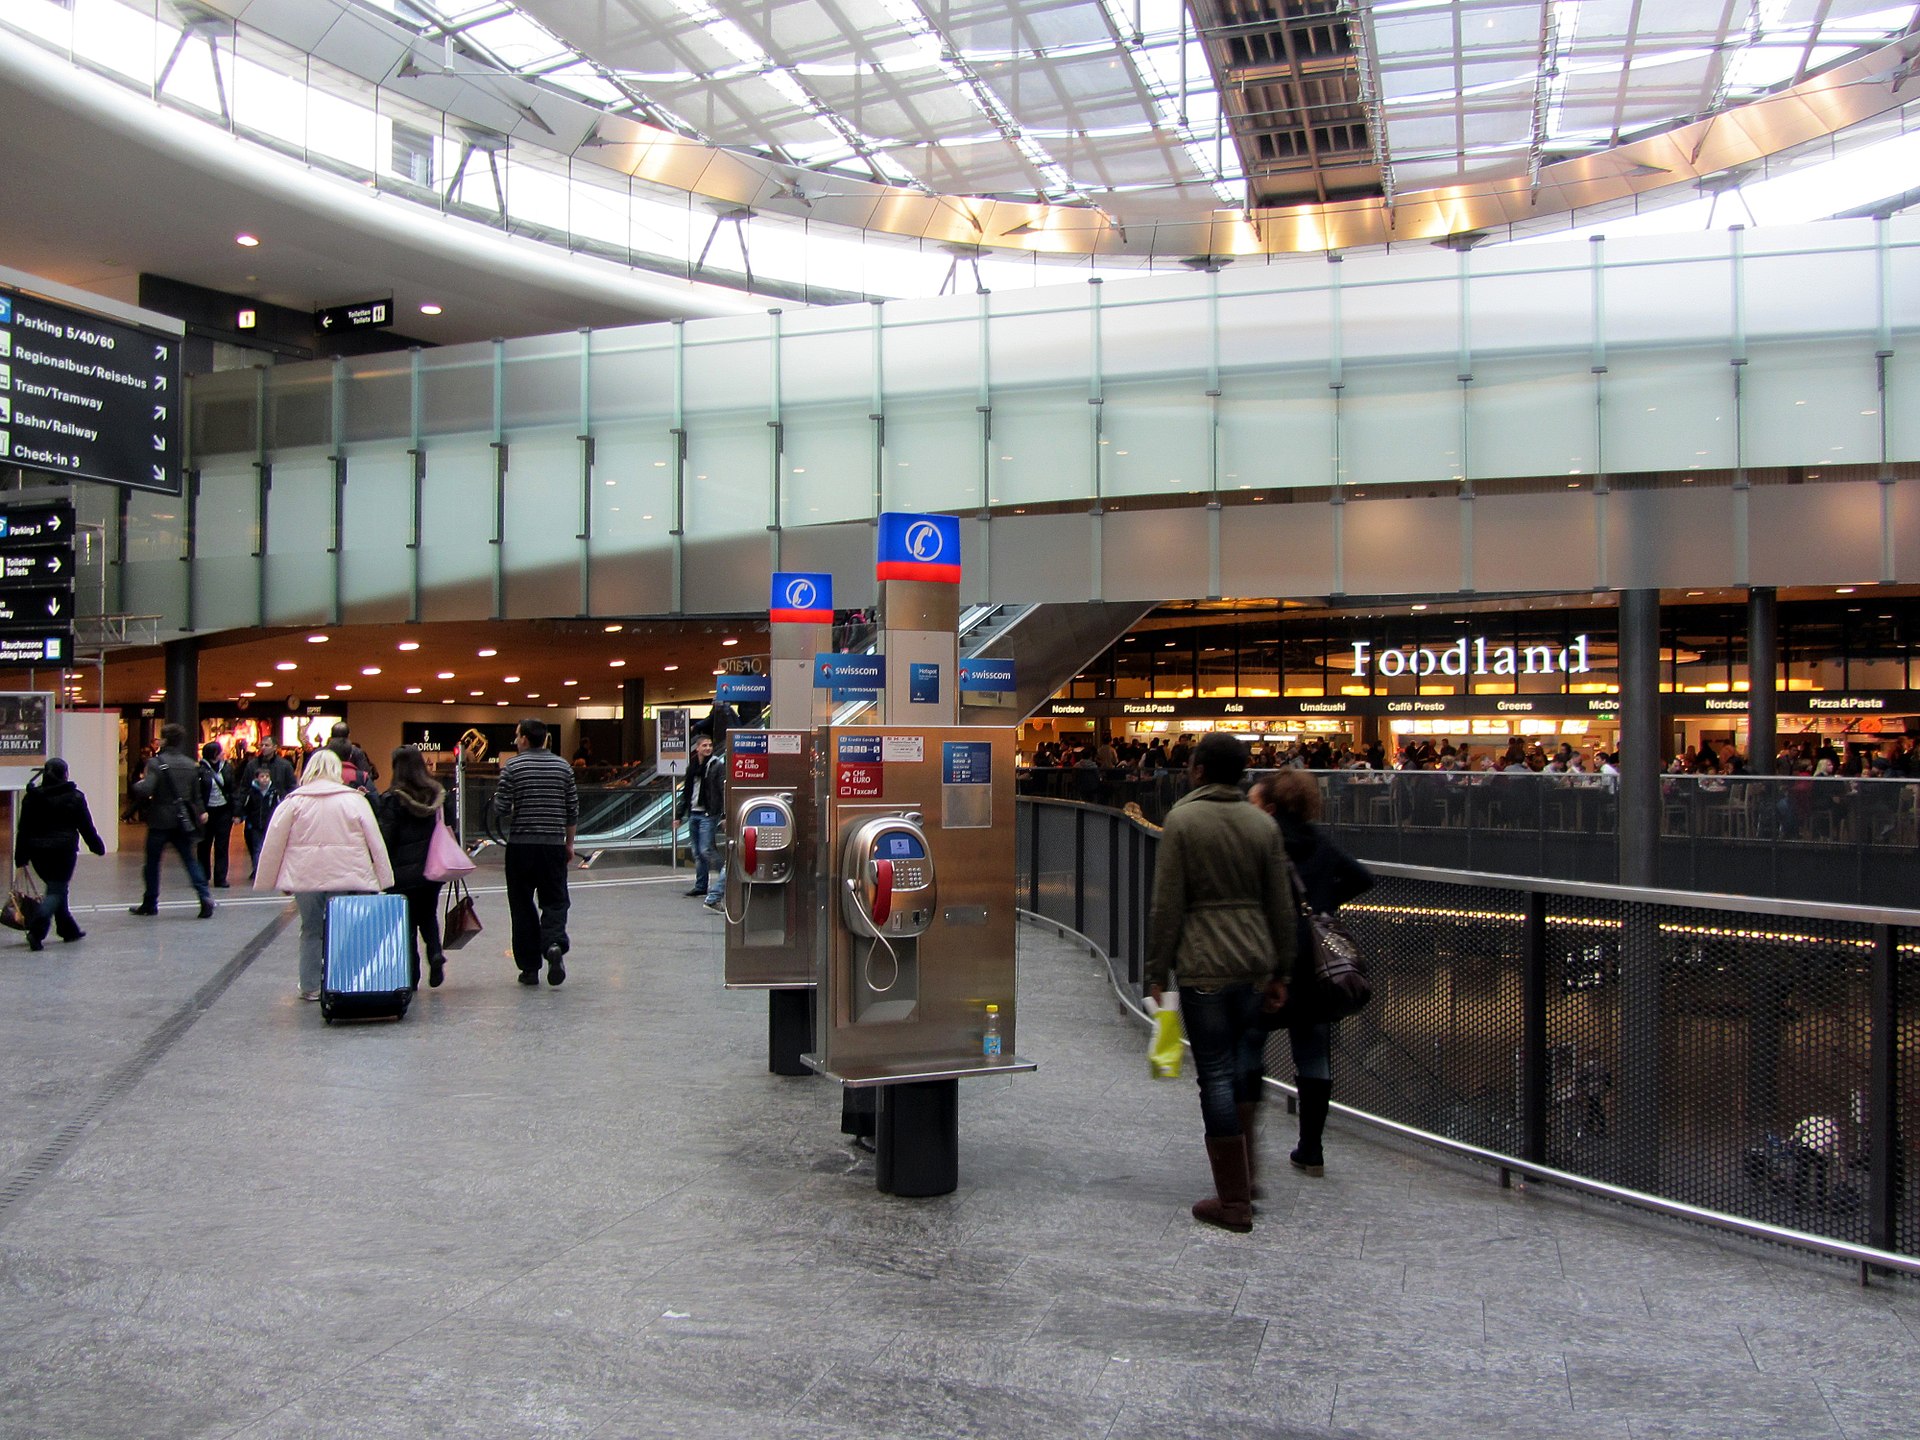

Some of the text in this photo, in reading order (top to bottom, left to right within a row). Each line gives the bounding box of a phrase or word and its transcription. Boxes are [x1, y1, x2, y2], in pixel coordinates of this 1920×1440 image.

[16, 314, 115, 350] Parking 5/40/60
[16, 346, 147, 389] Regionalbus/Reisebus
[15, 379, 104, 411] Tram/Tramway
[15, 412, 98, 442] Bahn/Railway
[14, 446, 80, 468] Check-in 3
[10, 524, 42, 536] Parking 3
[6, 558, 36, 567] Toiletten
[6, 567, 28, 576] Toilets
[2, 640, 44, 650] Raucherzone
[19, 650, 44, 660] Lounge
[1352, 634, 1590, 676] Foodland
[836, 665, 878, 675] swisscom
[972, 670, 1010, 680] swisscom
[1124, 704, 1174, 713] Pizza&Pasta
[1224, 703, 1244, 712] Asia
[1300, 703, 1345, 712] Umaizushi
[1388, 702, 1445, 711] Caffè Presto
[1497, 701, 1532, 711] Greens
[1810, 699, 1883, 708] Pizza&Pasta
[1052, 705, 1084, 714] Nordsee
